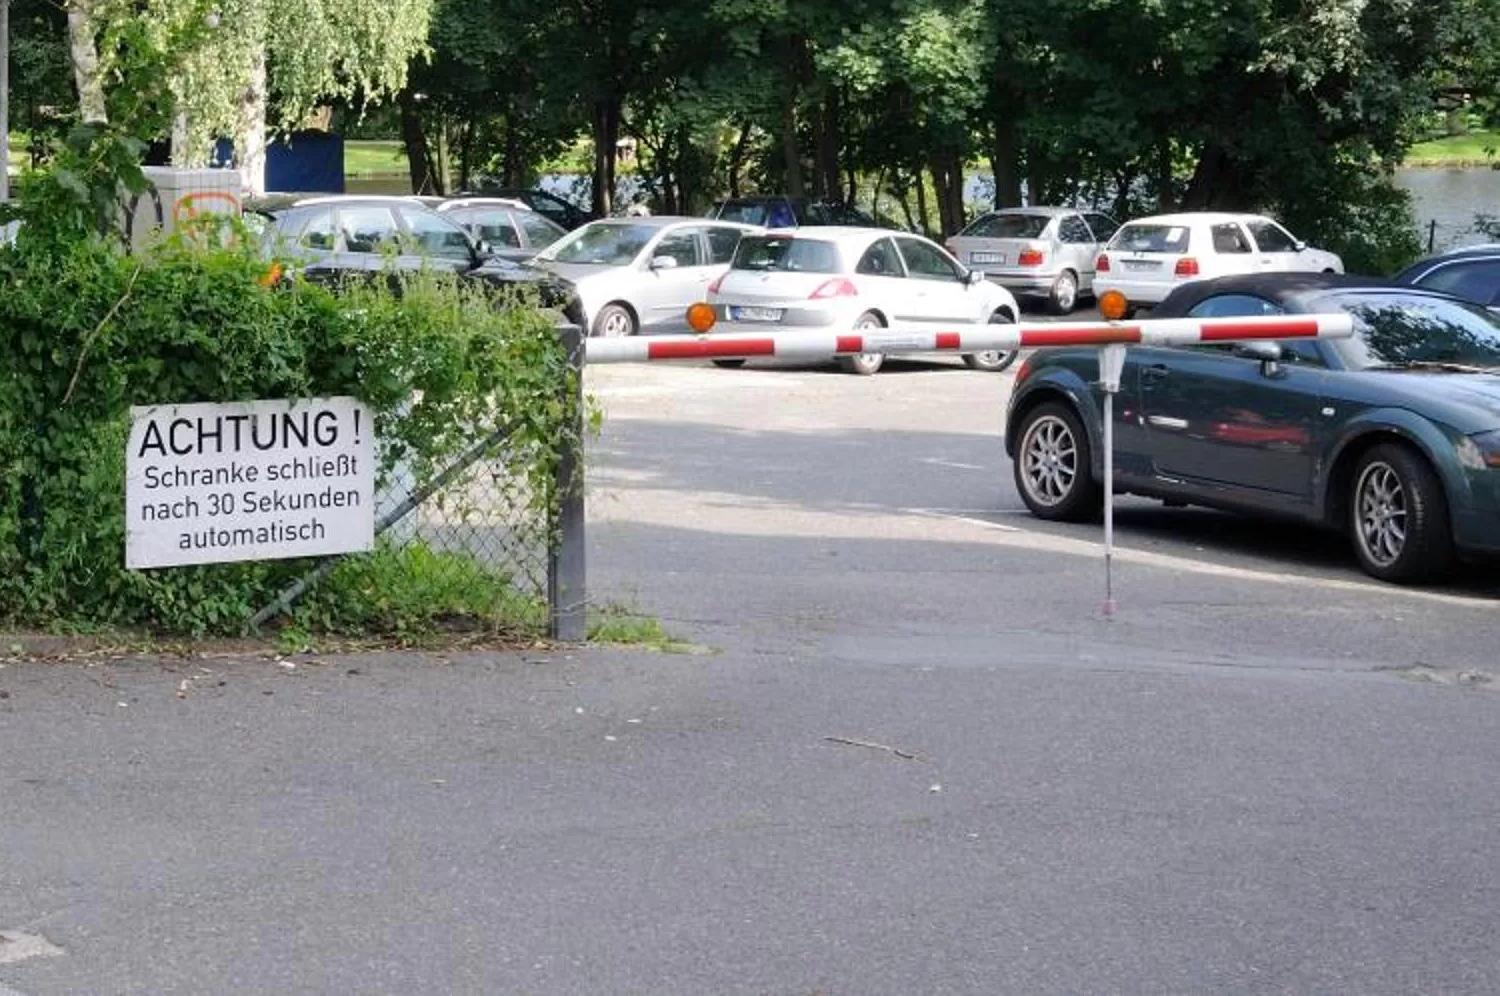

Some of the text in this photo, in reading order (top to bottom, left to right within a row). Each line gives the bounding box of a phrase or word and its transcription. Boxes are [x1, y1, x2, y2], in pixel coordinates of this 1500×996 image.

[138, 410, 338, 458] ACHTUNG
[144, 454, 358, 489] Schranke schließt
[141, 486, 360, 521] nach 30 Sekunden
[179, 518, 325, 549] automatisch
